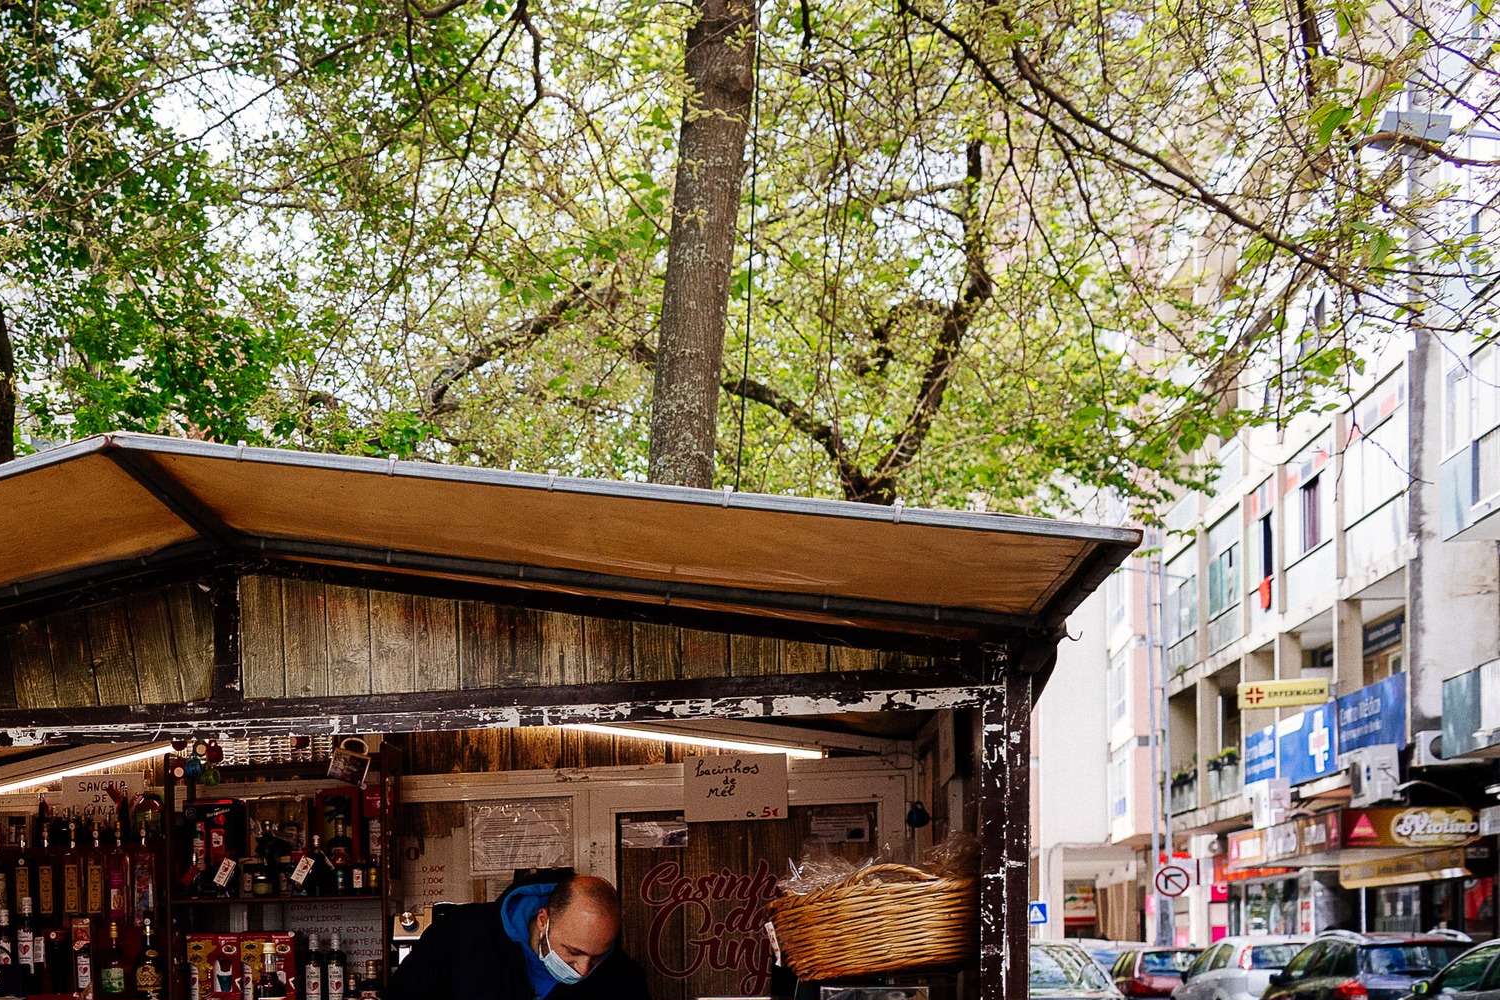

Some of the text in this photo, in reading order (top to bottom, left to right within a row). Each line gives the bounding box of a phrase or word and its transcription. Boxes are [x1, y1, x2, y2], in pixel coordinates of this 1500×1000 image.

[723, 775, 737, 786] de
[92, 794, 108, 803] DE
[761, 806, 780, 819] 5€
[421, 865, 446, 873] 0,60€
[422, 877, 445, 885] 1,00€
[422, 889, 445, 897] 1,00€
[318, 903, 344, 911] SHOT
[332, 926, 343, 934] DE
[346, 926, 374, 934] GINJA
[649, 899, 773, 997] Ginj
